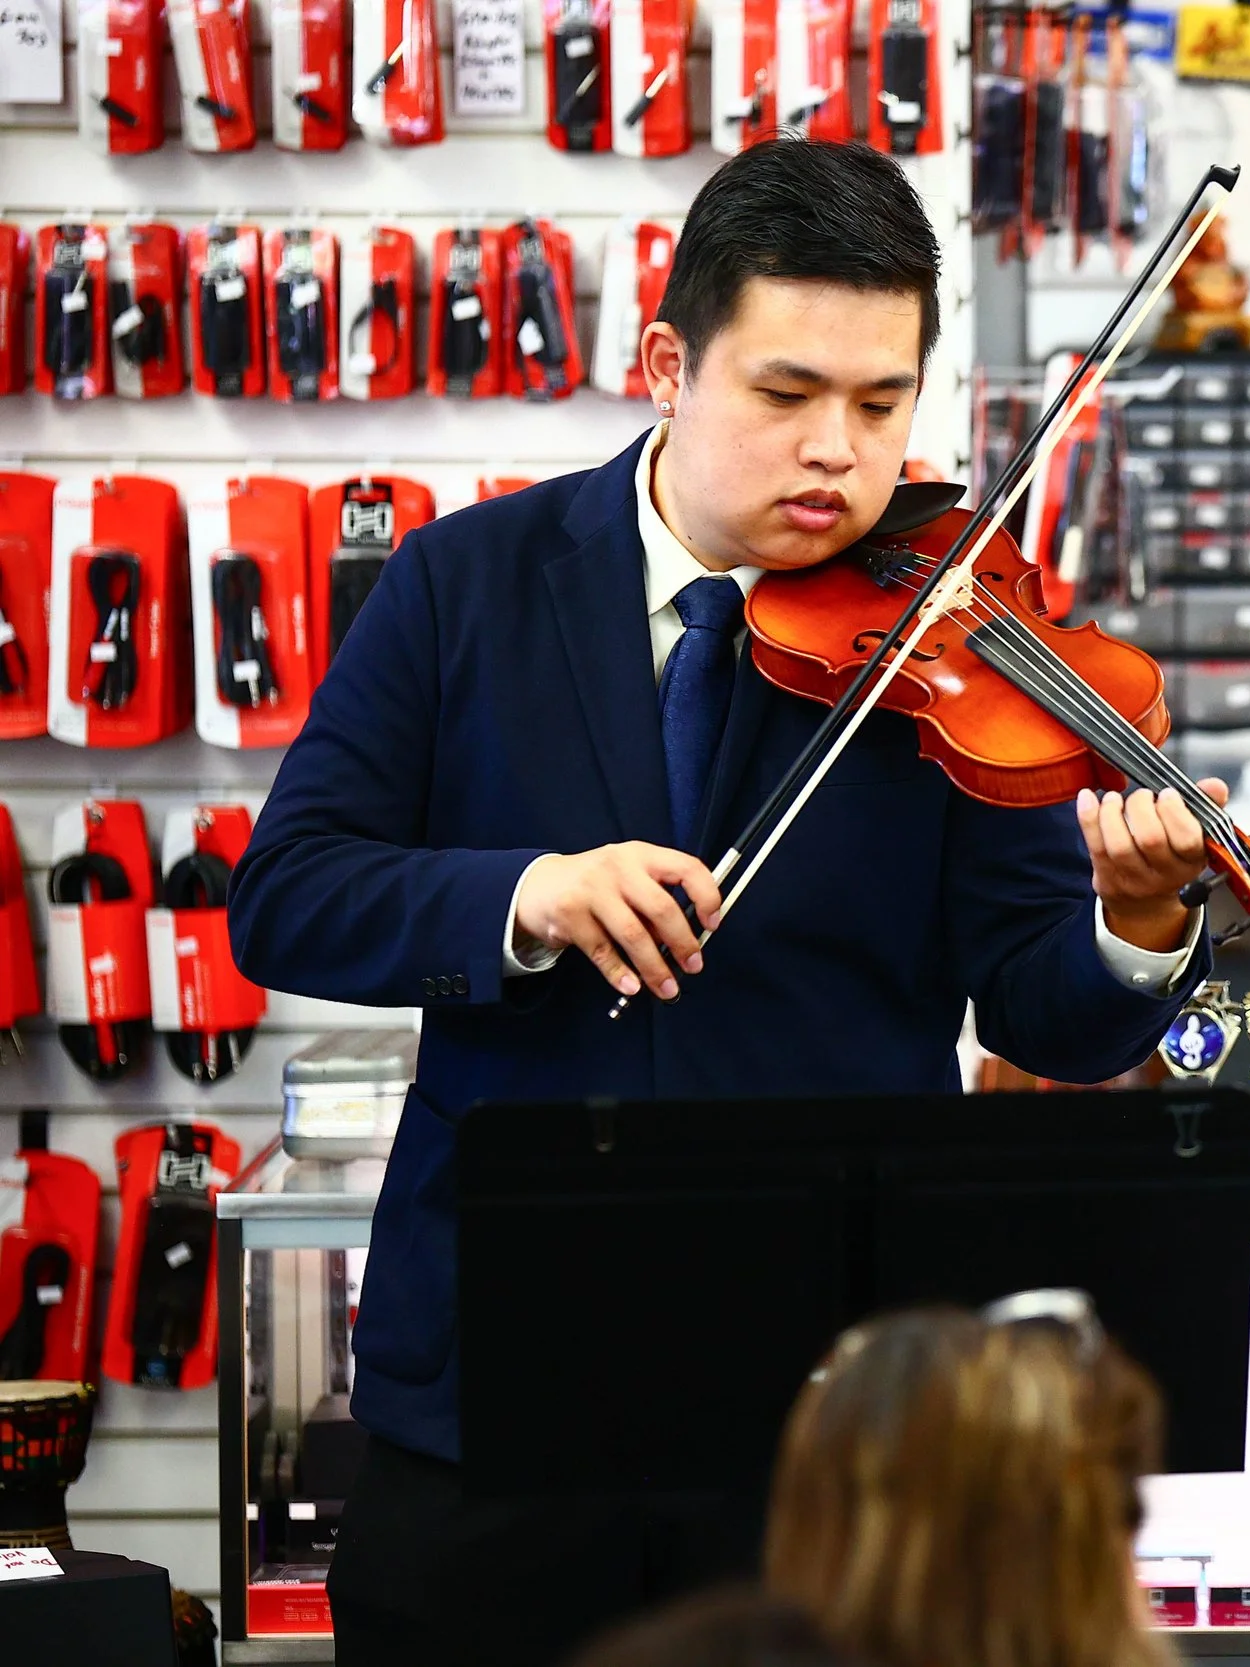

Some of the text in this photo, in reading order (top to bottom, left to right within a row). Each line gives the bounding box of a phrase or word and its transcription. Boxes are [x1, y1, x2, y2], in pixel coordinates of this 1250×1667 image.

[0, 1550, 27, 1560] Vol
[5, 1558, 58, 1569] Do not
